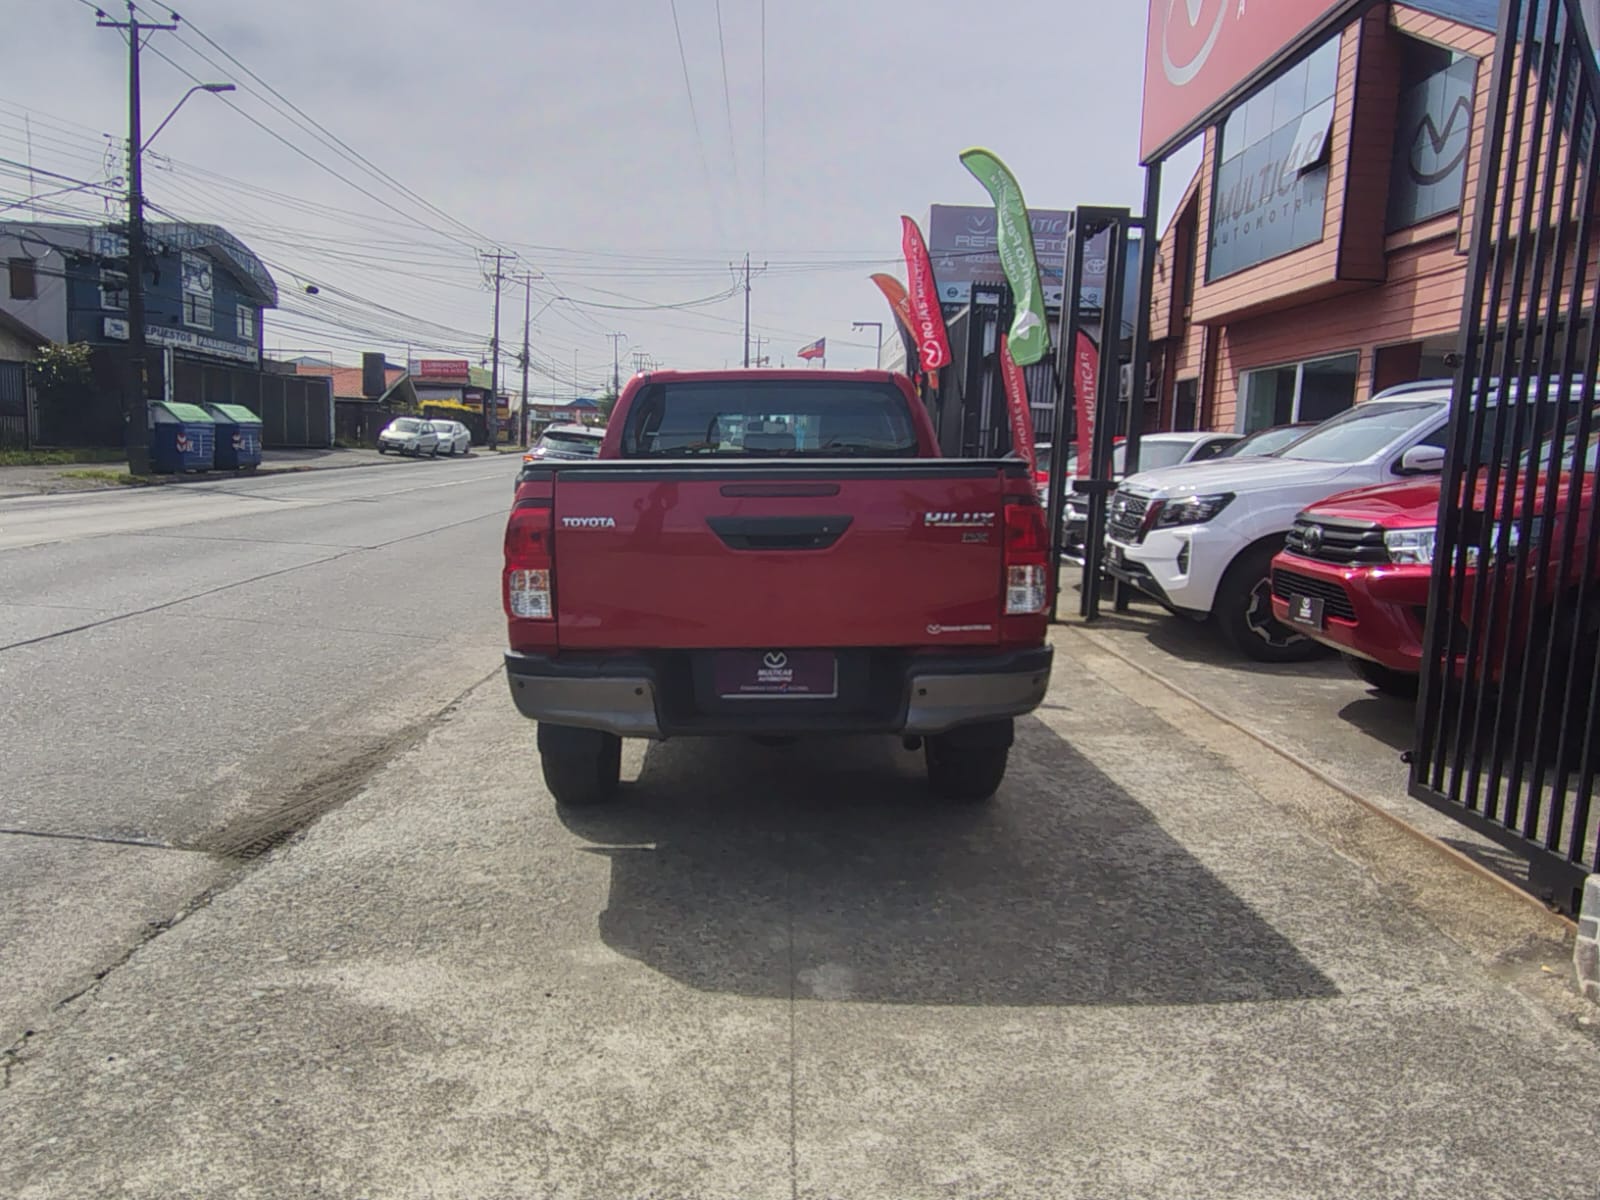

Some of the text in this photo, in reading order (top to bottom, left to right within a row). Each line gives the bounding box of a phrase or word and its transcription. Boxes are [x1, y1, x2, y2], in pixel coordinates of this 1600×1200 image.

[917, 302, 935, 338] ROJAS
[144, 325, 193, 343] EPUESTOS
[562, 517, 616, 528] TOYOTA
[924, 512, 995, 527] HILUX
